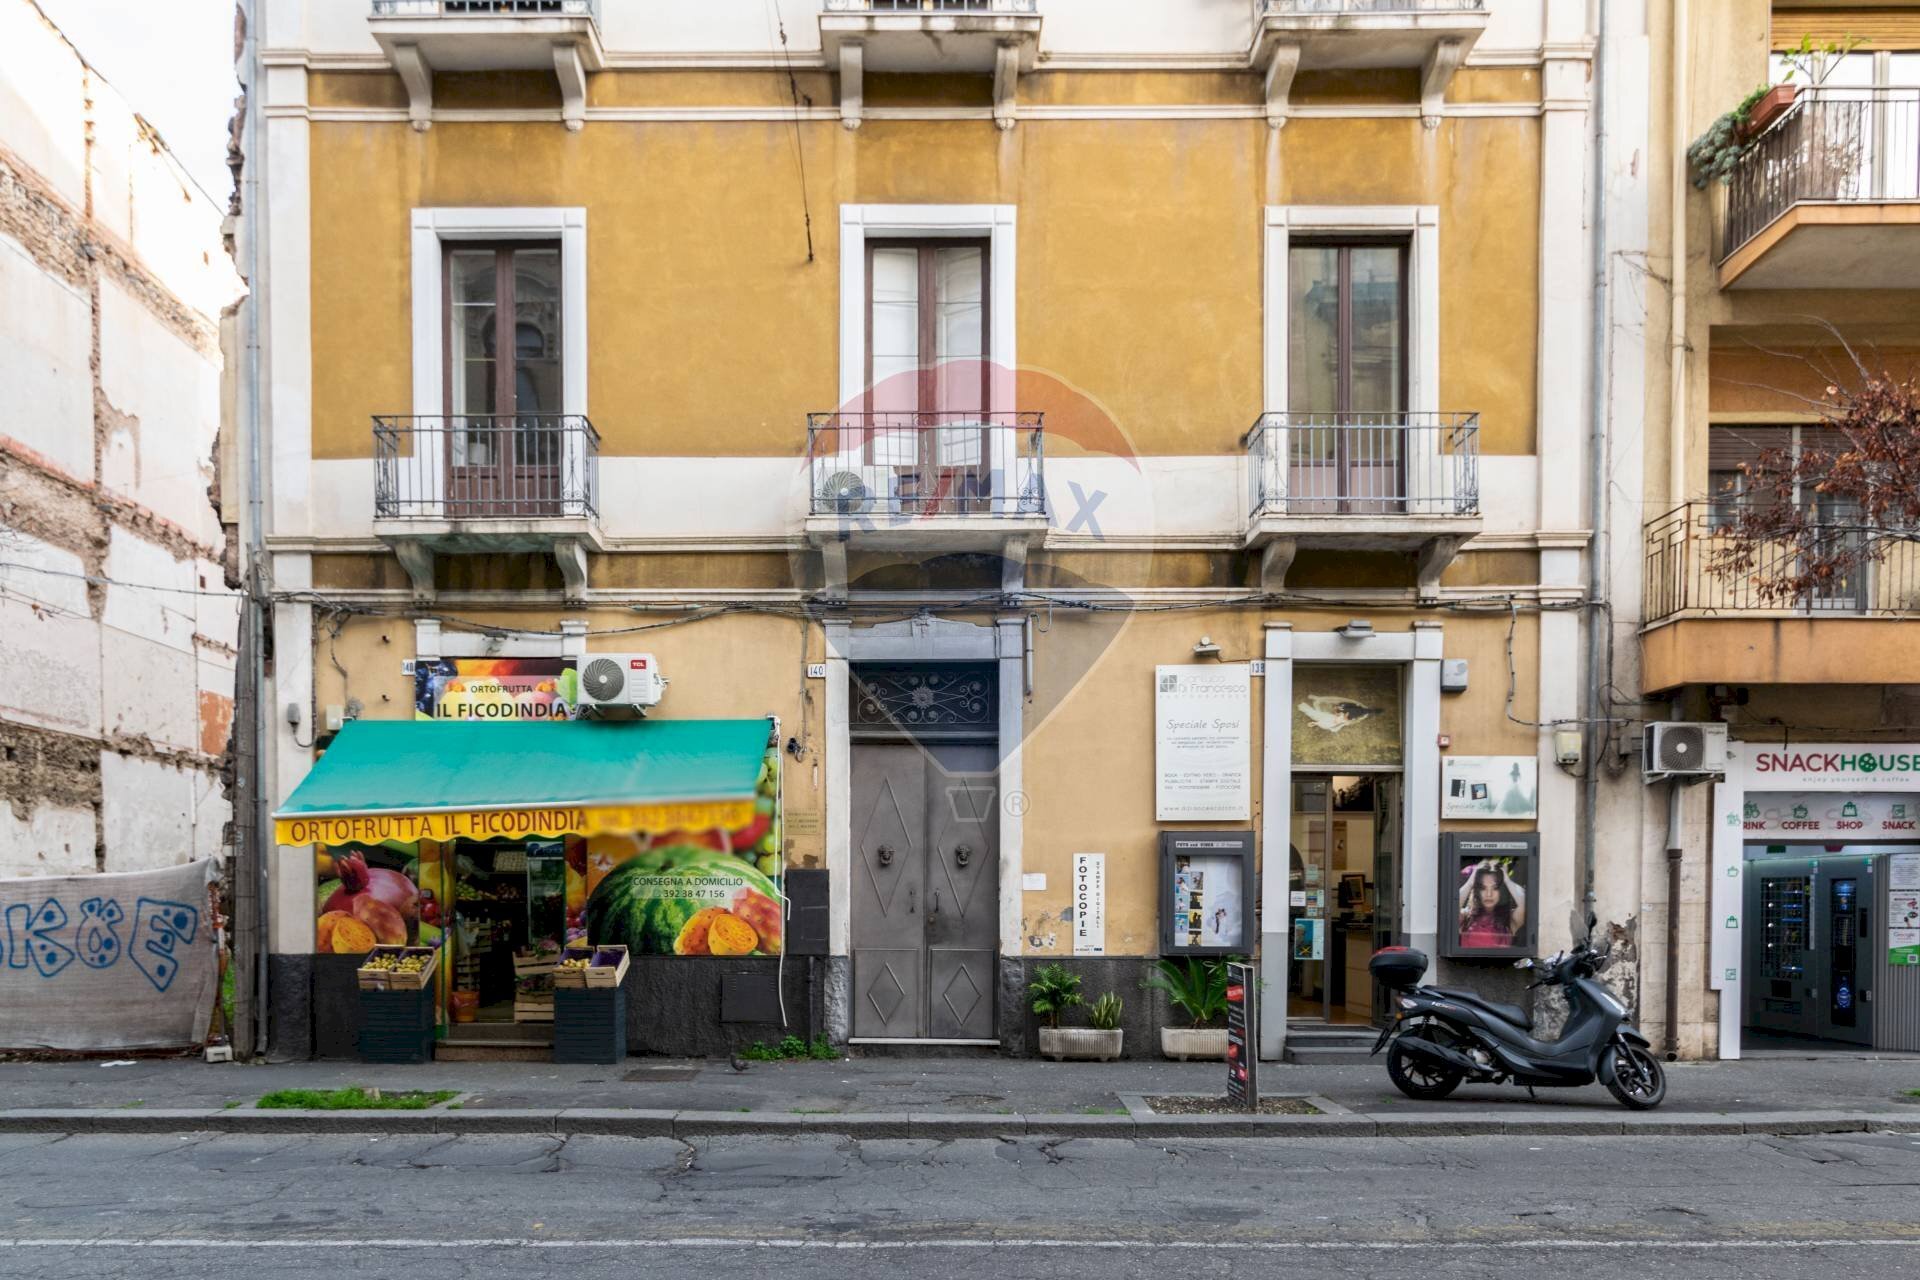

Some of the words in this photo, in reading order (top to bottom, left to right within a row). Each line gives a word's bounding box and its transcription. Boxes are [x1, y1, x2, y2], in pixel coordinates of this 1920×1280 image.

[810, 665, 824, 676] 140
[470, 685, 533, 694] ORTOFRUTTA
[437, 703, 451, 718] IL
[458, 703, 568, 718] FICODINDIA
[1166, 719, 1207, 733] Speciale
[291, 817, 432, 842] ORTOFRUTTA
[444, 815, 461, 835] IL
[470, 810, 588, 834] FICODINDIA
[1743, 821, 1766, 830] RINK
[1781, 821, 1820, 830] COFFEE
[1836, 821, 1863, 830] SHOP
[1882, 821, 1916, 830] SNACK
[633, 877, 684, 886] CONSEGNA
[686, 877, 692, 886] A
[694, 877, 743, 886] DOMICILIO
[664, 889, 680, 898] 392
[683, 889, 693, 898] 38
[695, 889, 705, 898] 47
[709, 889, 725, 898] 156
[1078, 856, 1088, 937] FOTOCOPIE
